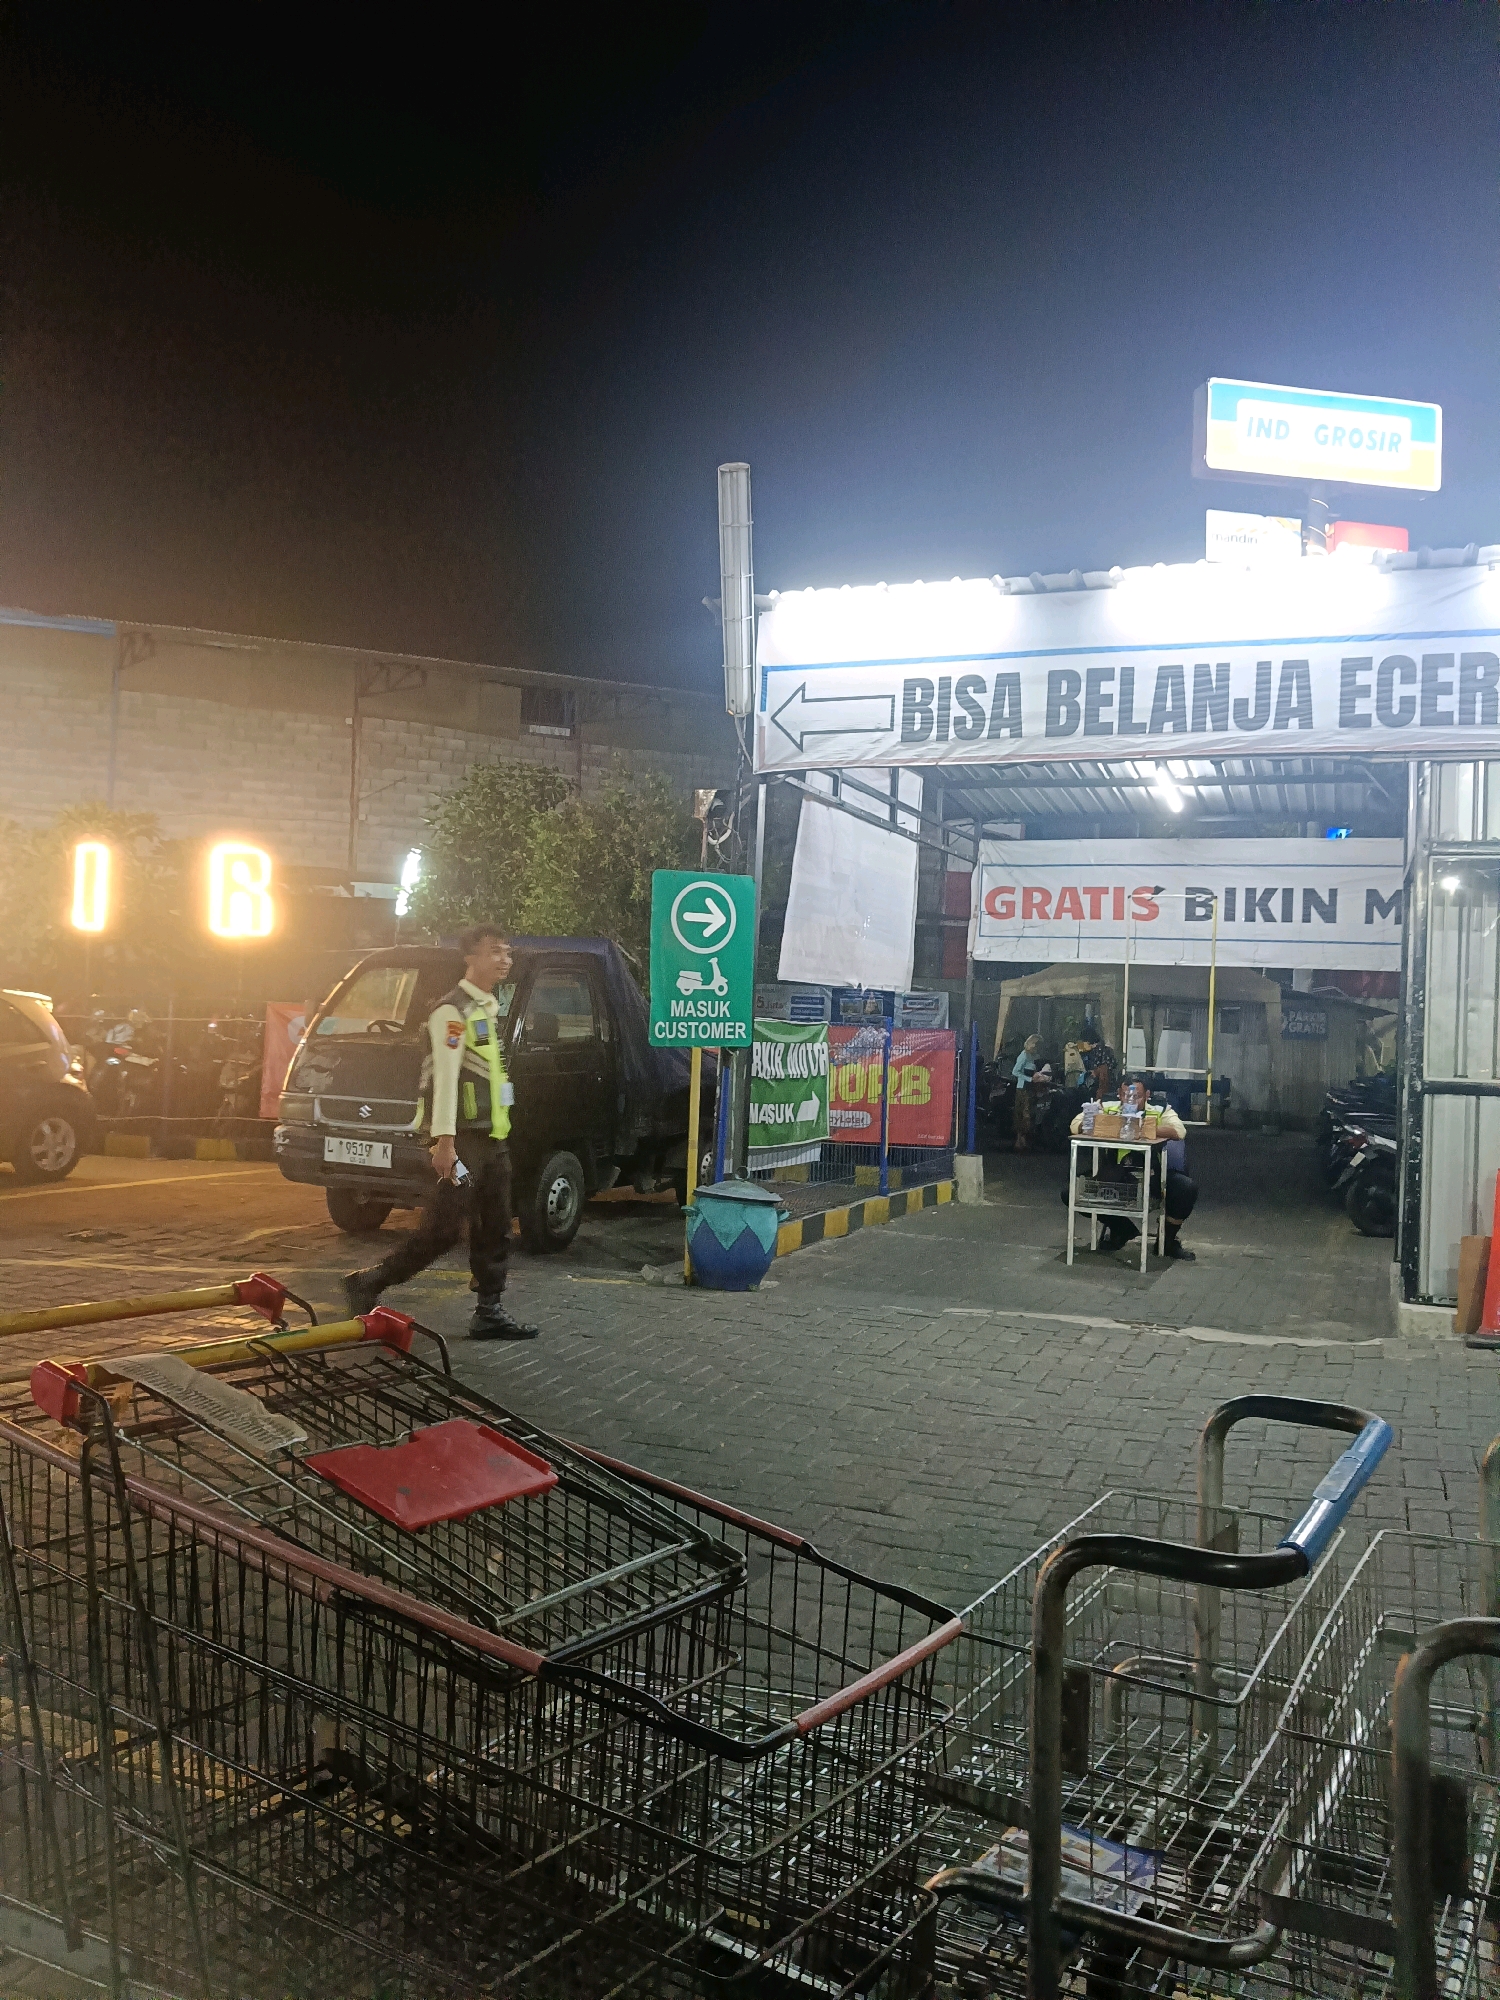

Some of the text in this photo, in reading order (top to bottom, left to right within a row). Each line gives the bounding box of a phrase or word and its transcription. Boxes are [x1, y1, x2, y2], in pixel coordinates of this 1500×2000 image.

[901, 651, 1500, 743] BISA BELANJA ECER
[985, 885, 1161, 922] GRATIS
[1184, 885, 1338, 924] BIKIN
[670, 1000, 731, 1018] MASUK
[654, 1021, 747, 1039] CUSTOMER
[749, 1103, 795, 1124] MASUK
[327, 1140, 389, 1159] L 9519 K
